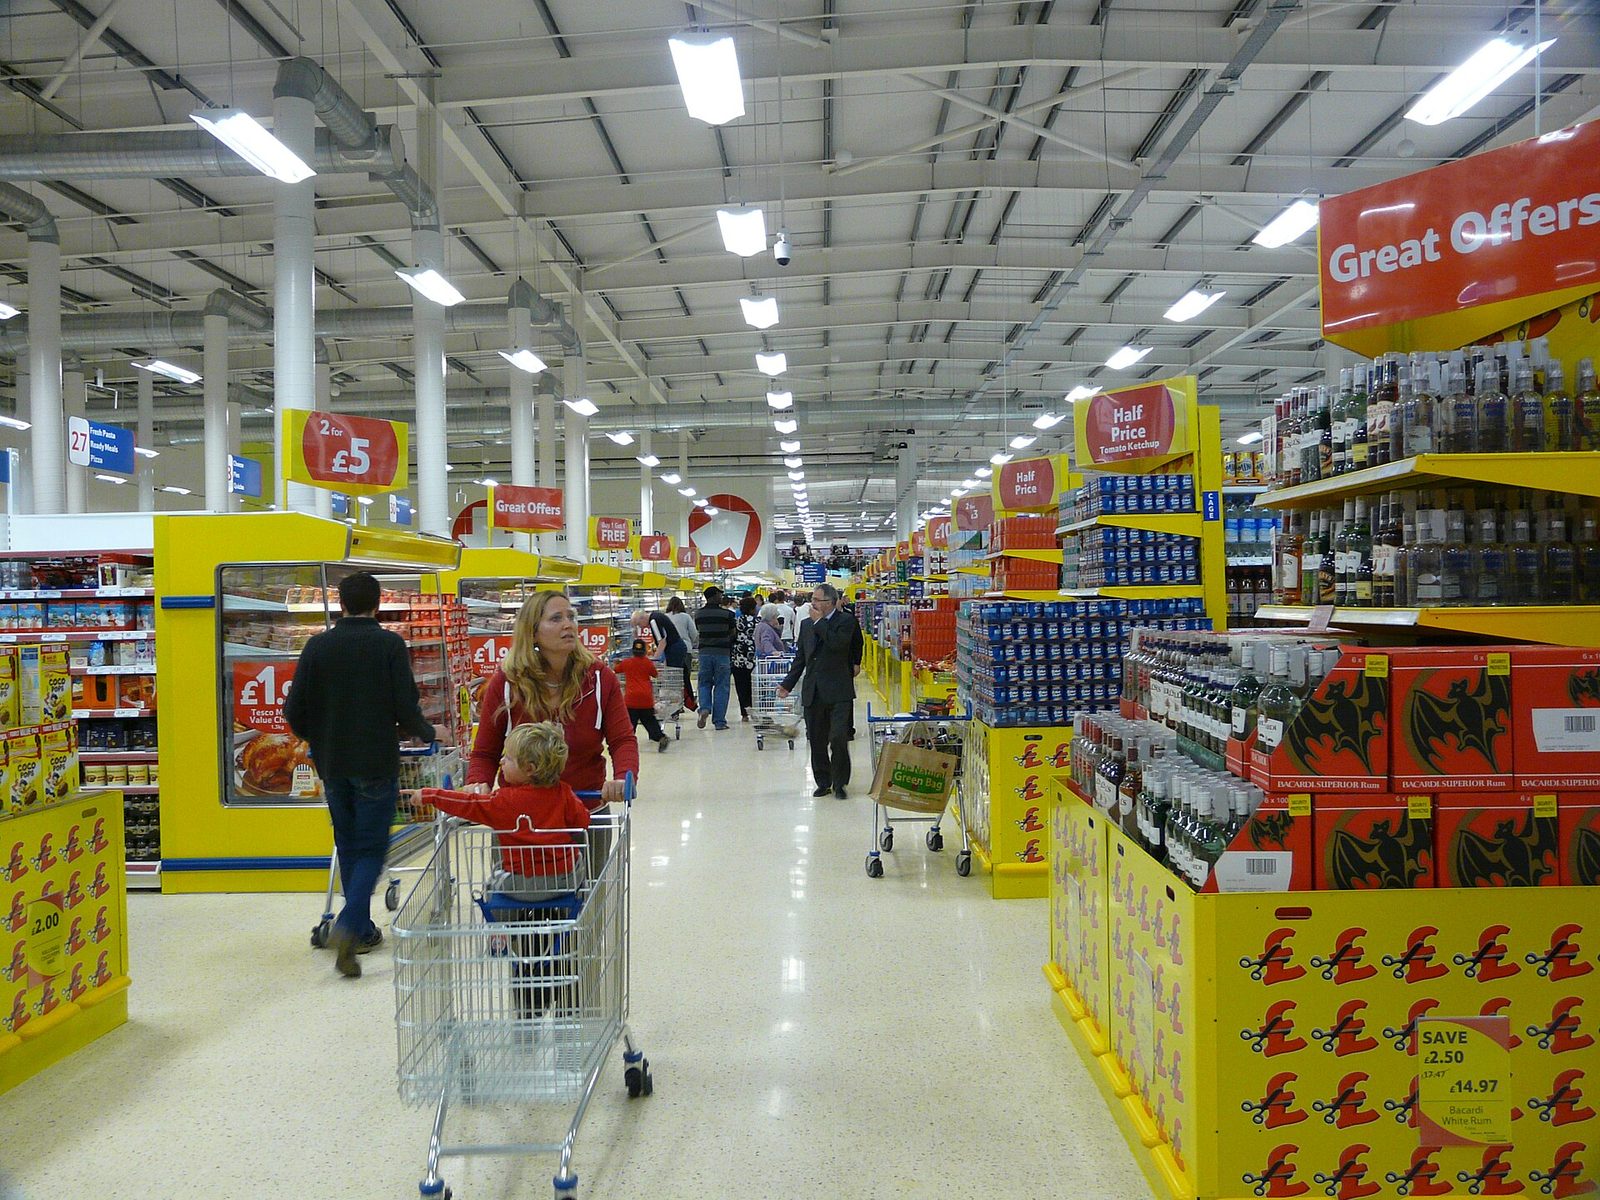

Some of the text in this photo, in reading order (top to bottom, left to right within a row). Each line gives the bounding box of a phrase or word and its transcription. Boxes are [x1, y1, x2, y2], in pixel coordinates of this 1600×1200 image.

[1328, 190, 1600, 285] Great Offers
[1113, 404, 1143, 424] Half
[90, 426, 116, 440] Fresh Pasta
[320, 419, 343, 437] 2 for
[1111, 425, 1146, 442] Price
[71, 431, 88, 452] 27
[90, 440, 119, 453] Ready Meals
[1099, 440, 1160, 455] Tomato Ketchup
[90, 455, 103, 464] Pizza
[331, 437, 371, 475] £5
[1016, 470, 1036, 483] Half
[1015, 483, 1037, 496] Price
[495, 499, 561, 516] Great Offers
[601, 530, 626, 542] FREE
[649, 540, 660, 554] £1
[48, 677, 66, 686] COCO
[250, 708, 275, 716] Tesco
[249, 716, 273, 724] Value
[17, 761, 37, 772] COCO
[50, 755, 68, 767] COCO
[895, 761, 946, 778] The Natural
[894, 771, 943, 791] Green Bag
[1314, 780, 1359, 789] SUPERIOR
[1360, 781, 1380, 789] Rum
[1441, 780, 1486, 788] SUPERIOR
[1486, 780, 1506, 788] Rum
[1559, 778, 1600, 788] SUPERIO
[31, 912, 59, 936] £2.00
[1422, 1031, 1468, 1044] SAVE
[1424, 1050, 1465, 1064] £2.50
[1449, 1079, 1499, 1093] £14.97
[1449, 1105, 1484, 1115] Bacardi
[1442, 1116, 1492, 1126] White Rum
